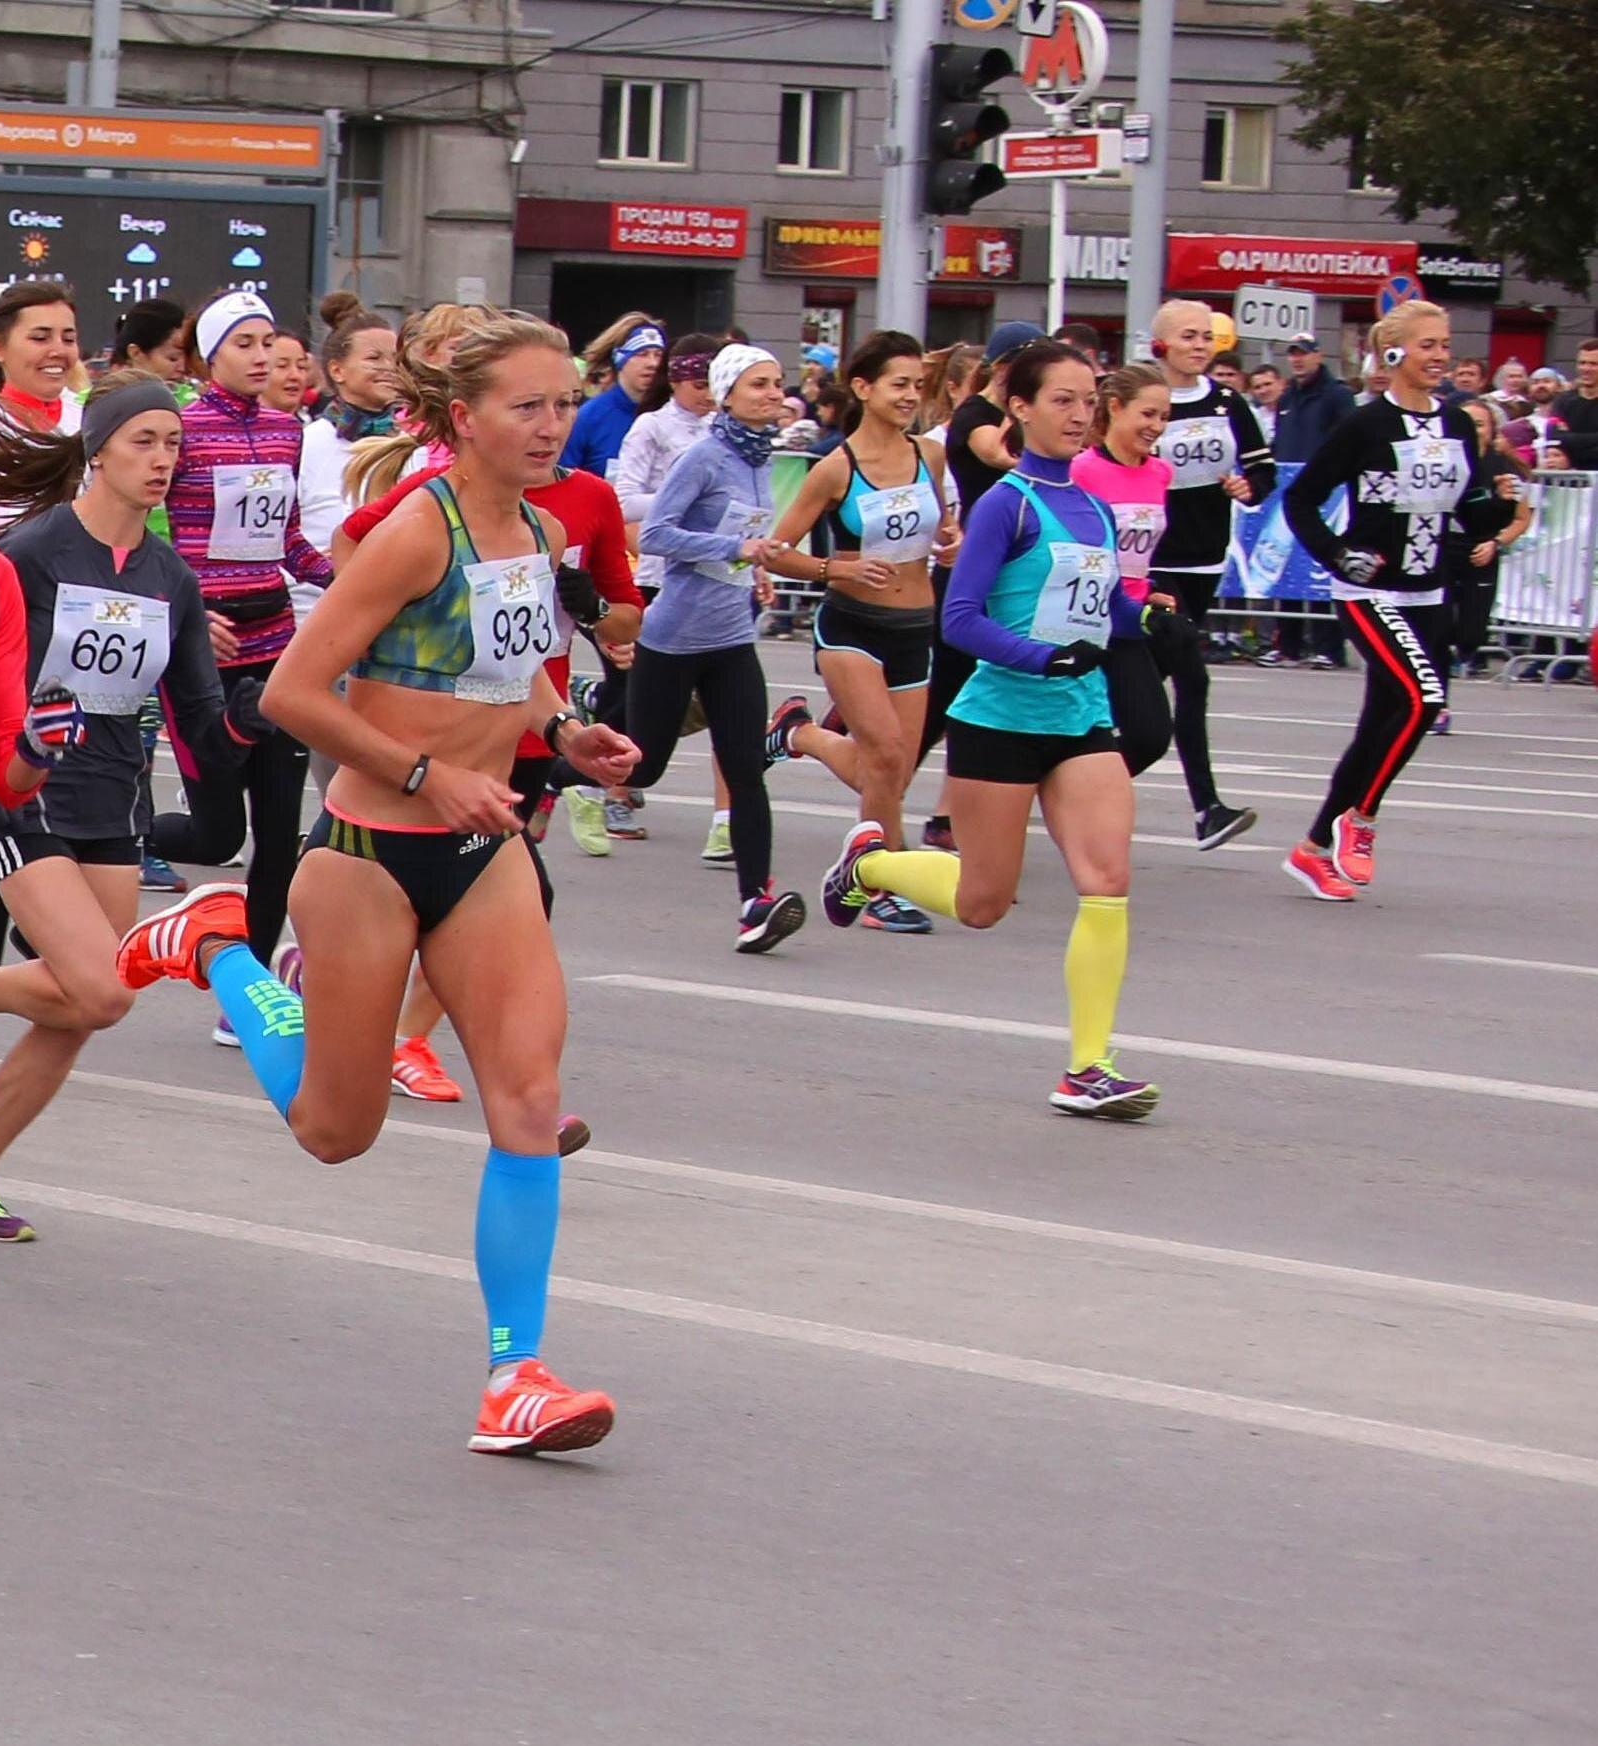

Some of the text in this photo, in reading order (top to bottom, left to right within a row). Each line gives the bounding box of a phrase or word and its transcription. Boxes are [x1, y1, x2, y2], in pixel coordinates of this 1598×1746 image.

[1022, 9, 1085, 87] М
[87, 127, 137, 146] Метро
[8, 208, 64, 229] Сейчас
[119, 213, 167, 236] Вечер
[228, 218, 267, 237] Ночь
[618, 207, 686, 228] ПРОДАМ
[687, 211, 711, 227] 150
[1217, 250, 1391, 276] ФАРМАКОПЕЙКА
[1240, 299, 1310, 331] СТОП
[1173, 439, 1224, 467] 943
[1410, 463, 1458, 489] 954
[235, 495, 287, 529] 134
[885, 511, 920, 541] 82
[493, 603, 552, 661] 933
[71, 629, 147, 679] 661
